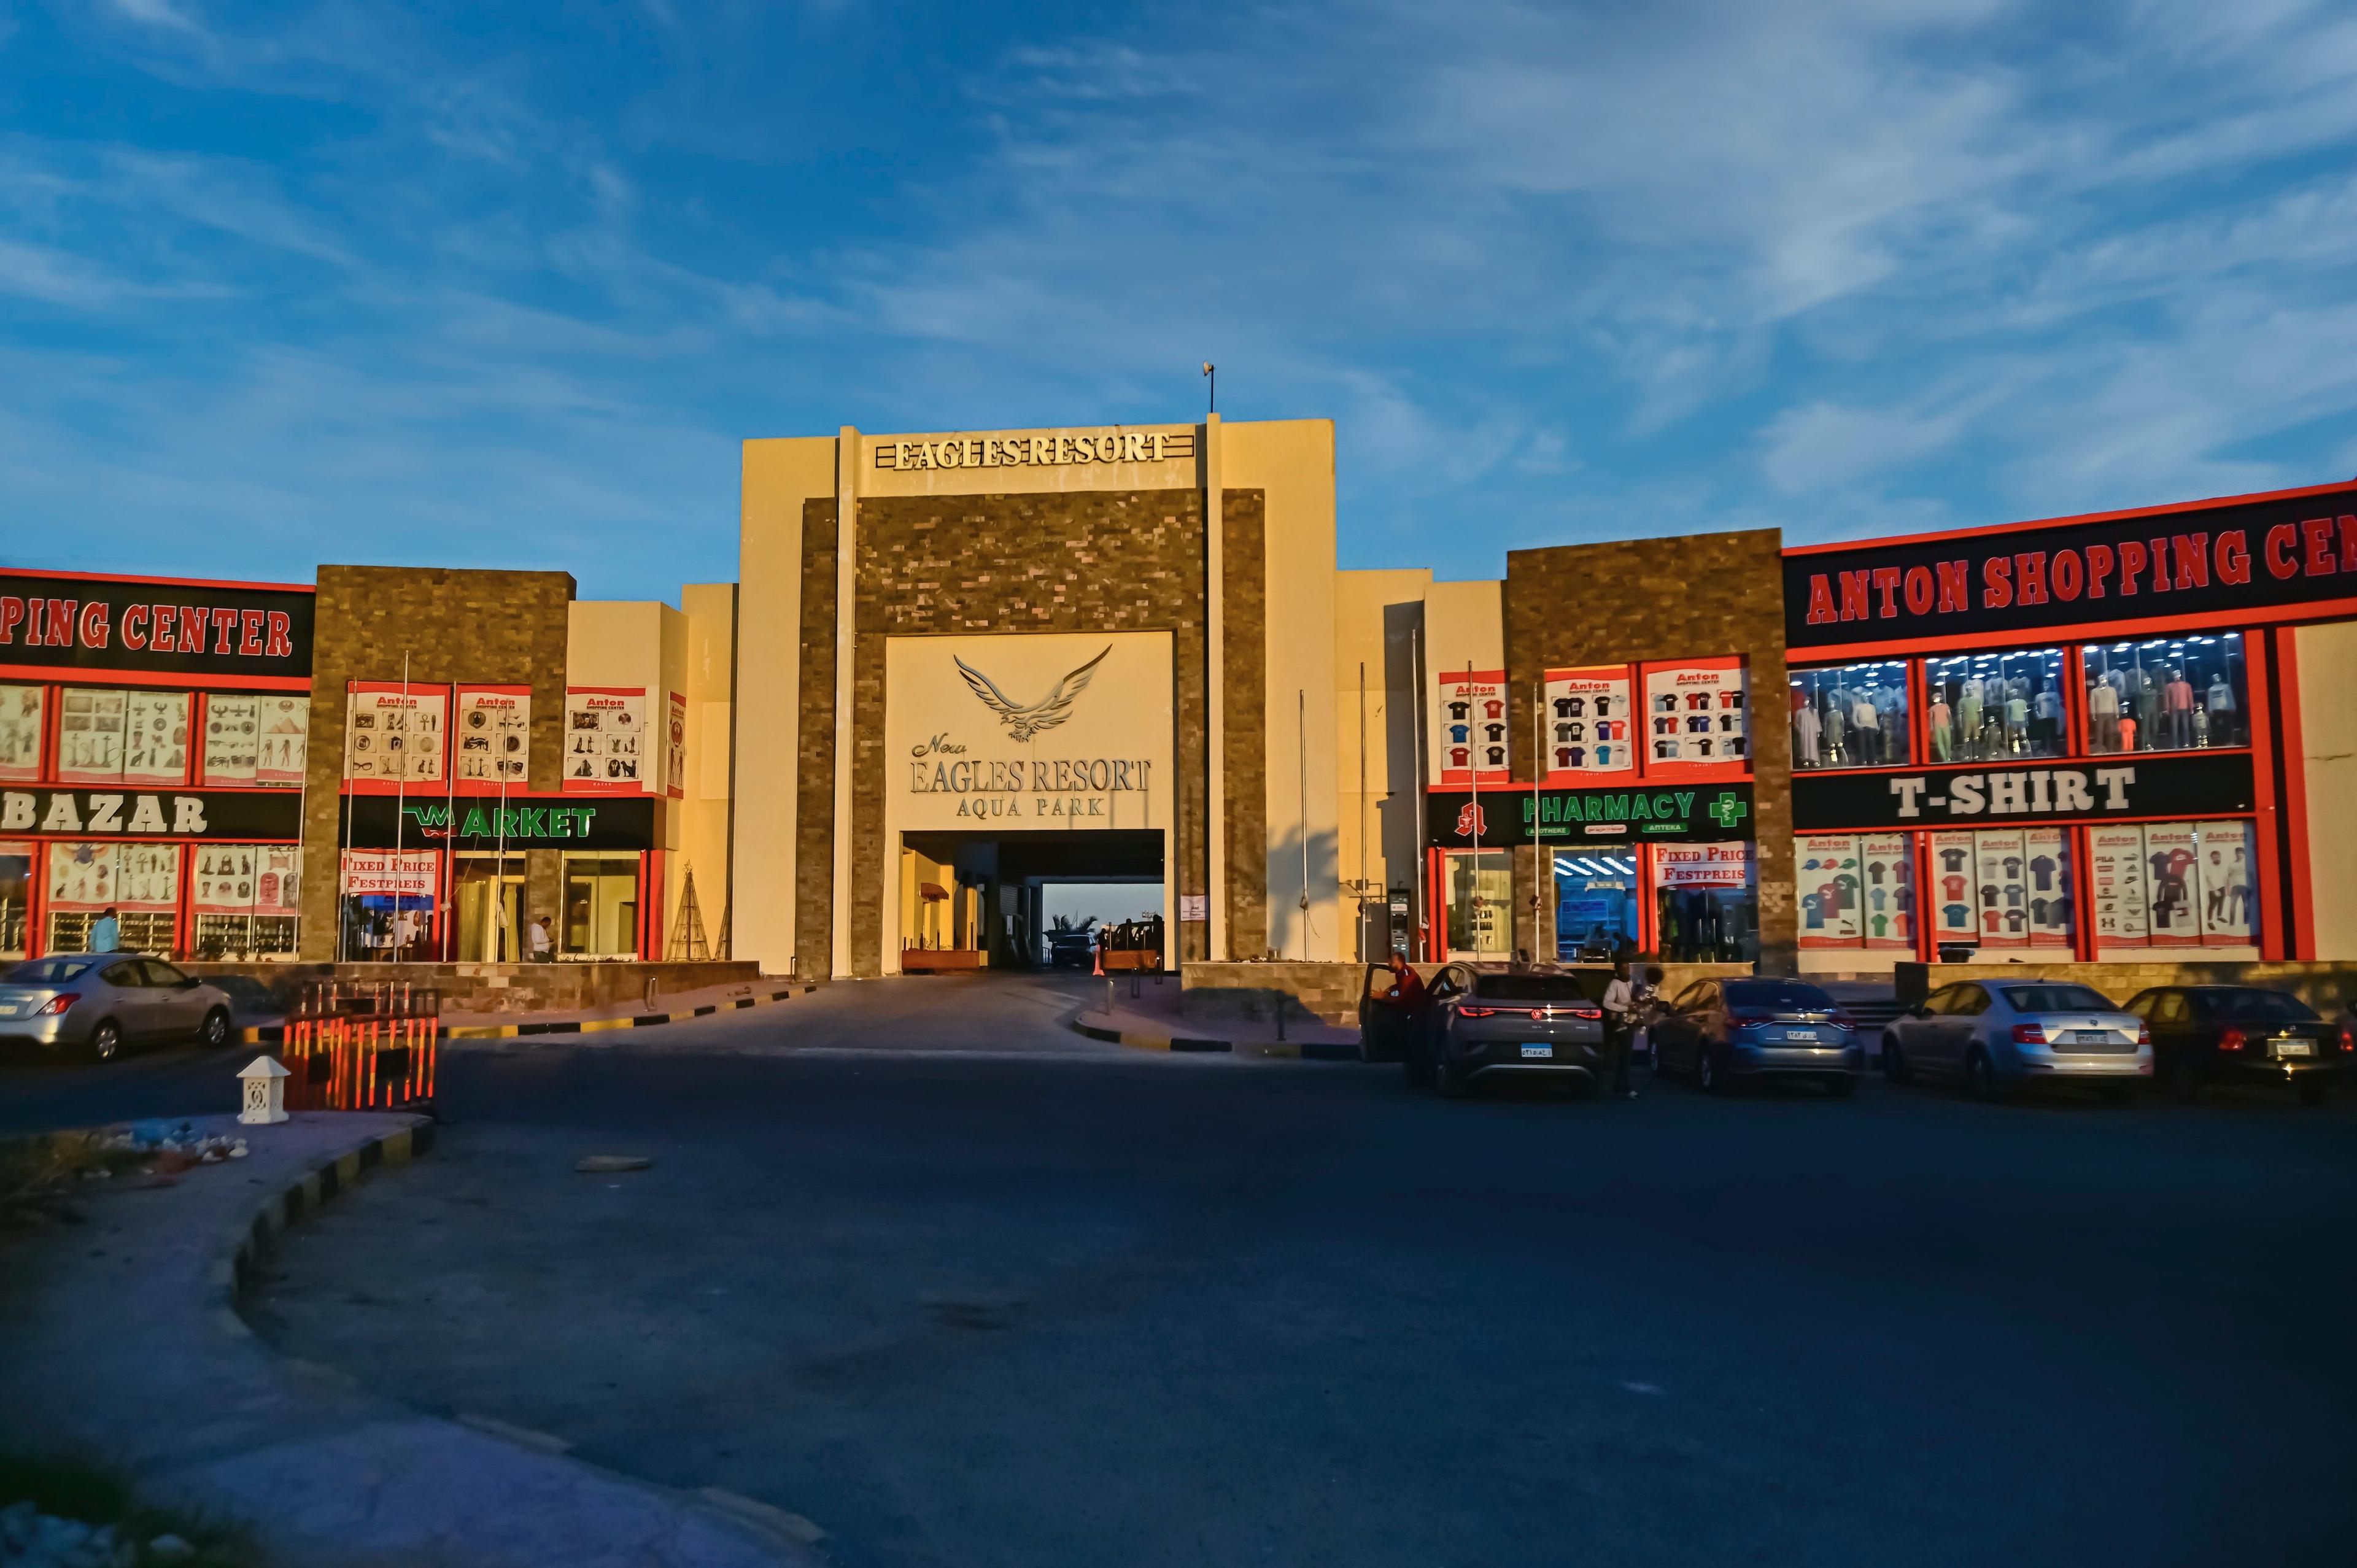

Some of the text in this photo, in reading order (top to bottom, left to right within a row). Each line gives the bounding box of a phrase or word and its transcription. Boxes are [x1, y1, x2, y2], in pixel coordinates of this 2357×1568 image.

[893, 432, 1170, 470] EAGLES RESORT
[1806, 560, 1970, 625] ANTON
[1983, 529, 2251, 609] SHOPPING
[0, 596, 293, 657] PING CENTER
[911, 732, 967, 757] New
[910, 759, 1151, 793] EAGLES RESORT
[1523, 792, 1695, 822] PHARMACY
[1889, 767, 2137, 819] T-SHIRT
[1, 791, 207, 833] BAZAR
[956, 798, 1105, 820] AQUA PARK
[342, 857, 435, 872] FIXED PRICE
[1656, 847, 1754, 862] FIXED PRICE
[348, 876, 425, 889] FESTPREIS
[1663, 867, 1746, 880] FESTPREIS
